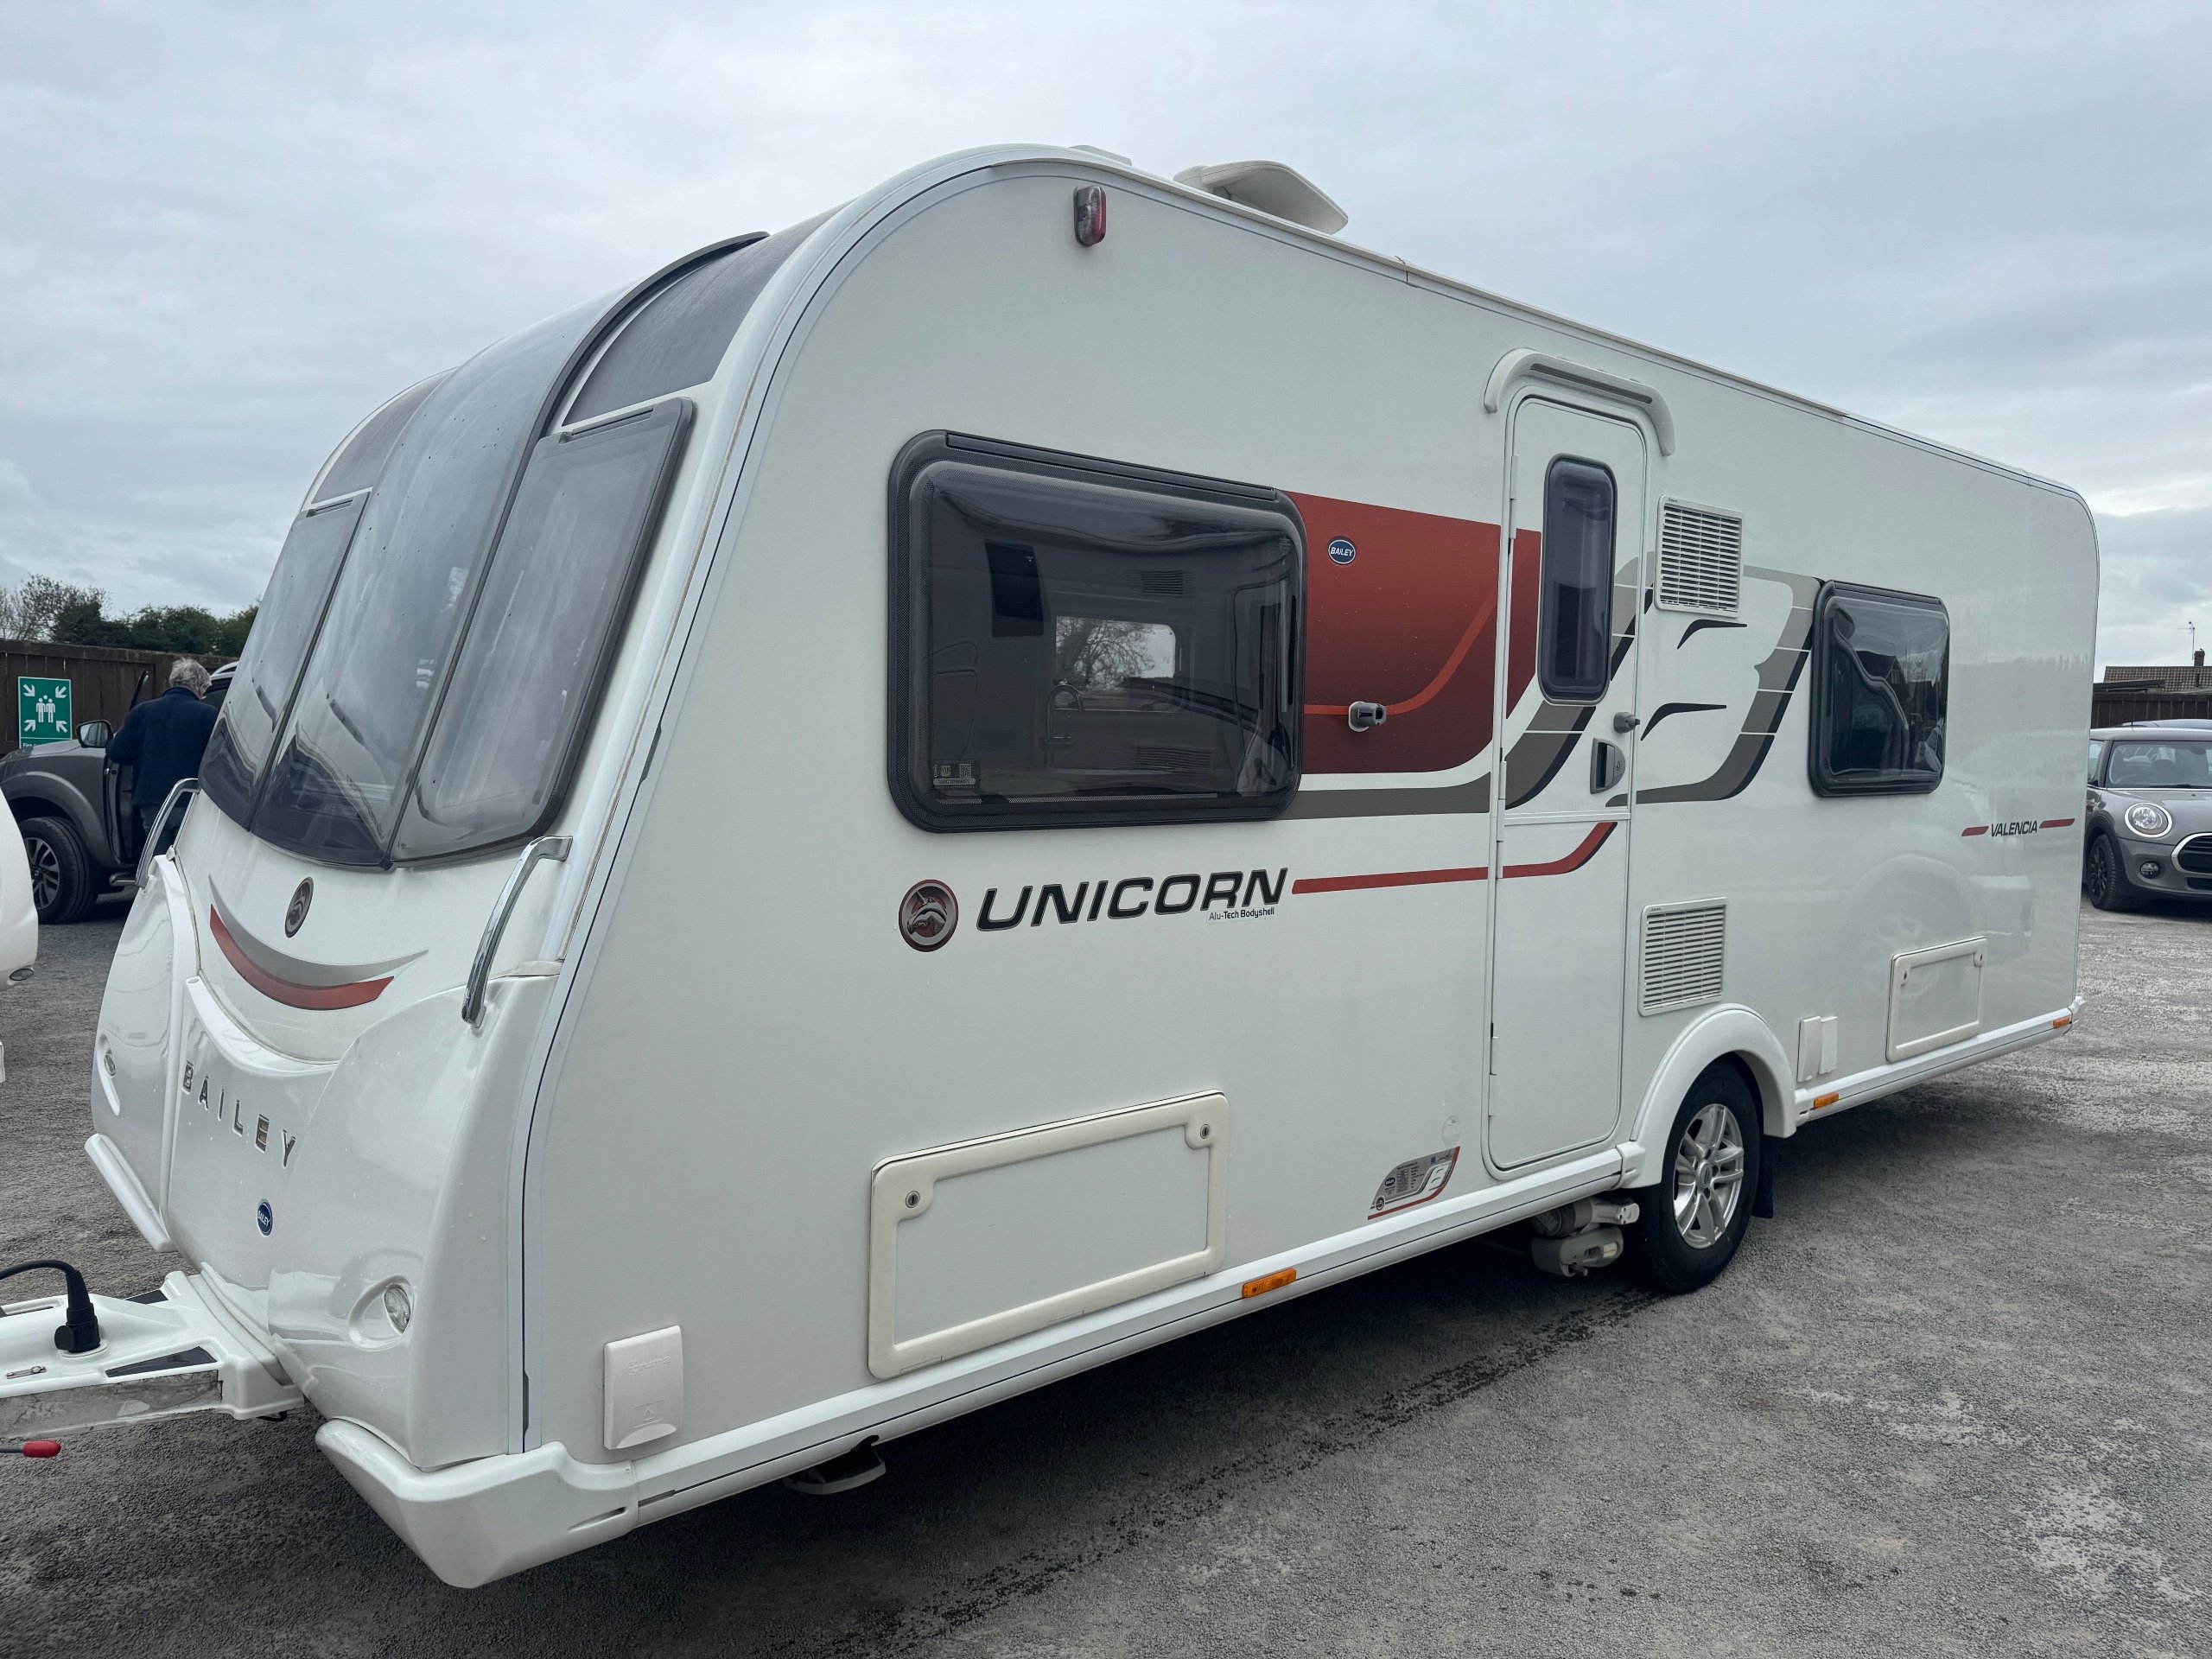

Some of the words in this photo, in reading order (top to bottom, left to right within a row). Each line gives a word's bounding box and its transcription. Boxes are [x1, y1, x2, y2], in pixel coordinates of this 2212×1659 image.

[1331, 547, 1354, 557] BAILEY
[1991, 821, 2037, 837] VALENCIA
[976, 868, 1288, 931] UNICORN
[1209, 910, 1239, 921] Alu-Tech
[1241, 907, 1274, 918] Bodyshell
[182, 1060, 296, 1169] BAILEY
